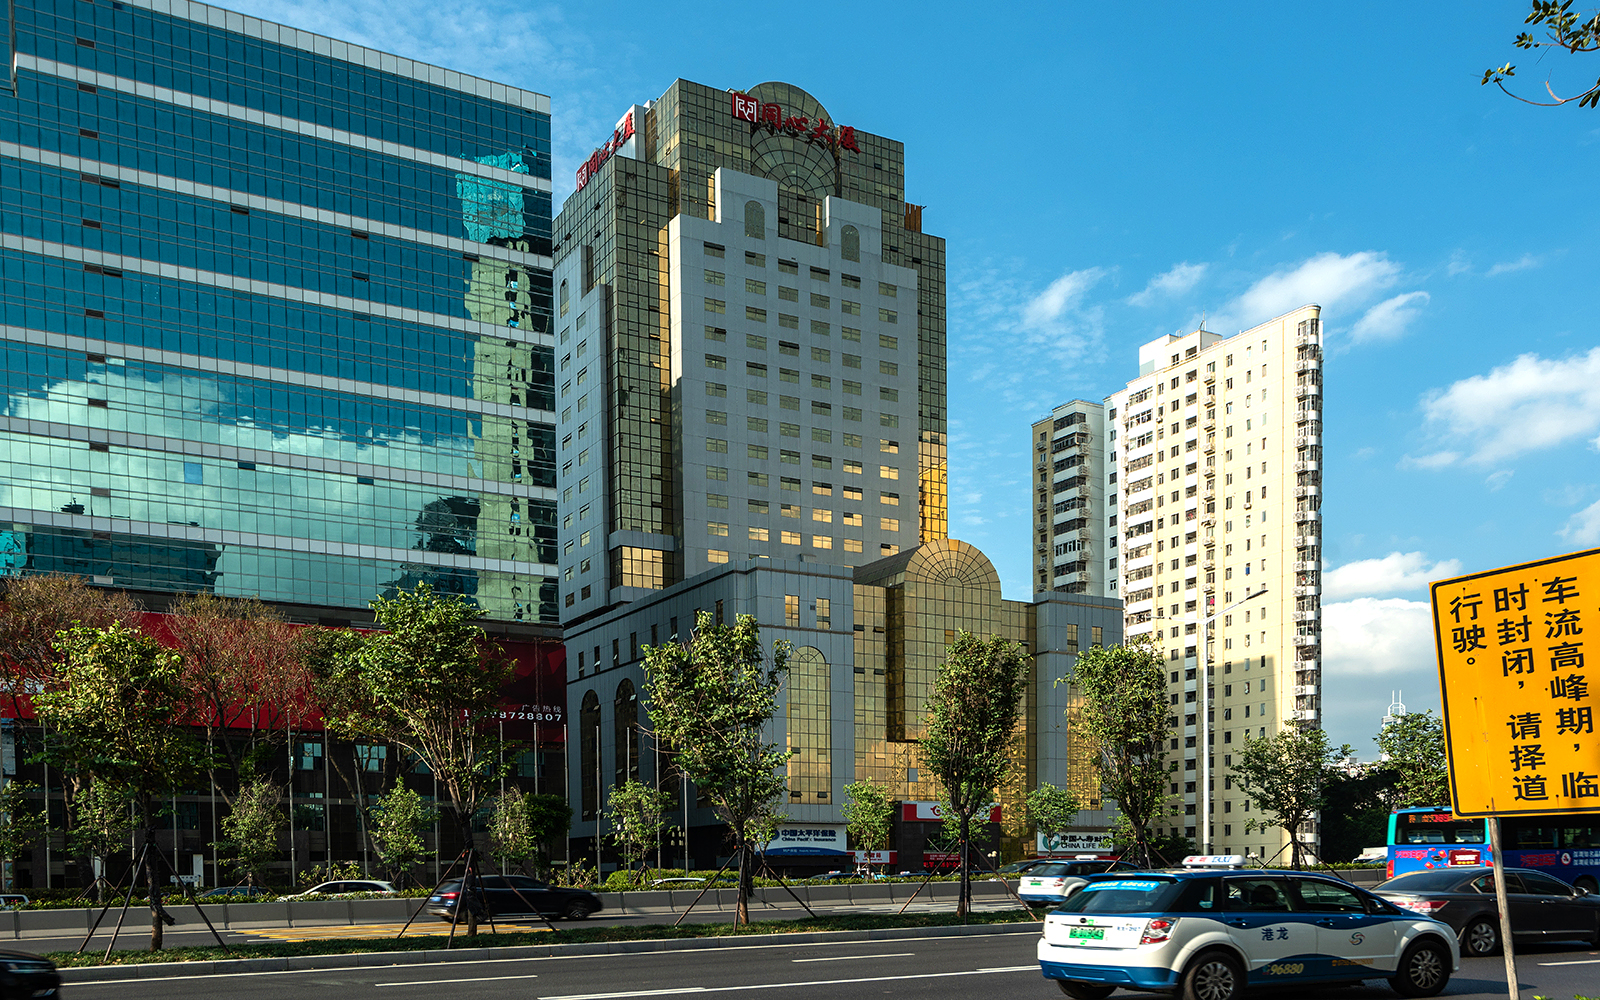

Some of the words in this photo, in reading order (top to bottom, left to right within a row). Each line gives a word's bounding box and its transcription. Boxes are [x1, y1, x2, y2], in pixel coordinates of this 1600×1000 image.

[762, 103, 861, 153] 同心大厦
[521, 704, 562, 713] 广告热线
[781, 829, 837, 837] 中国太平洋保险
[1261, 927, 1289, 941] 港龙
[1270, 963, 1304, 975] 96880
